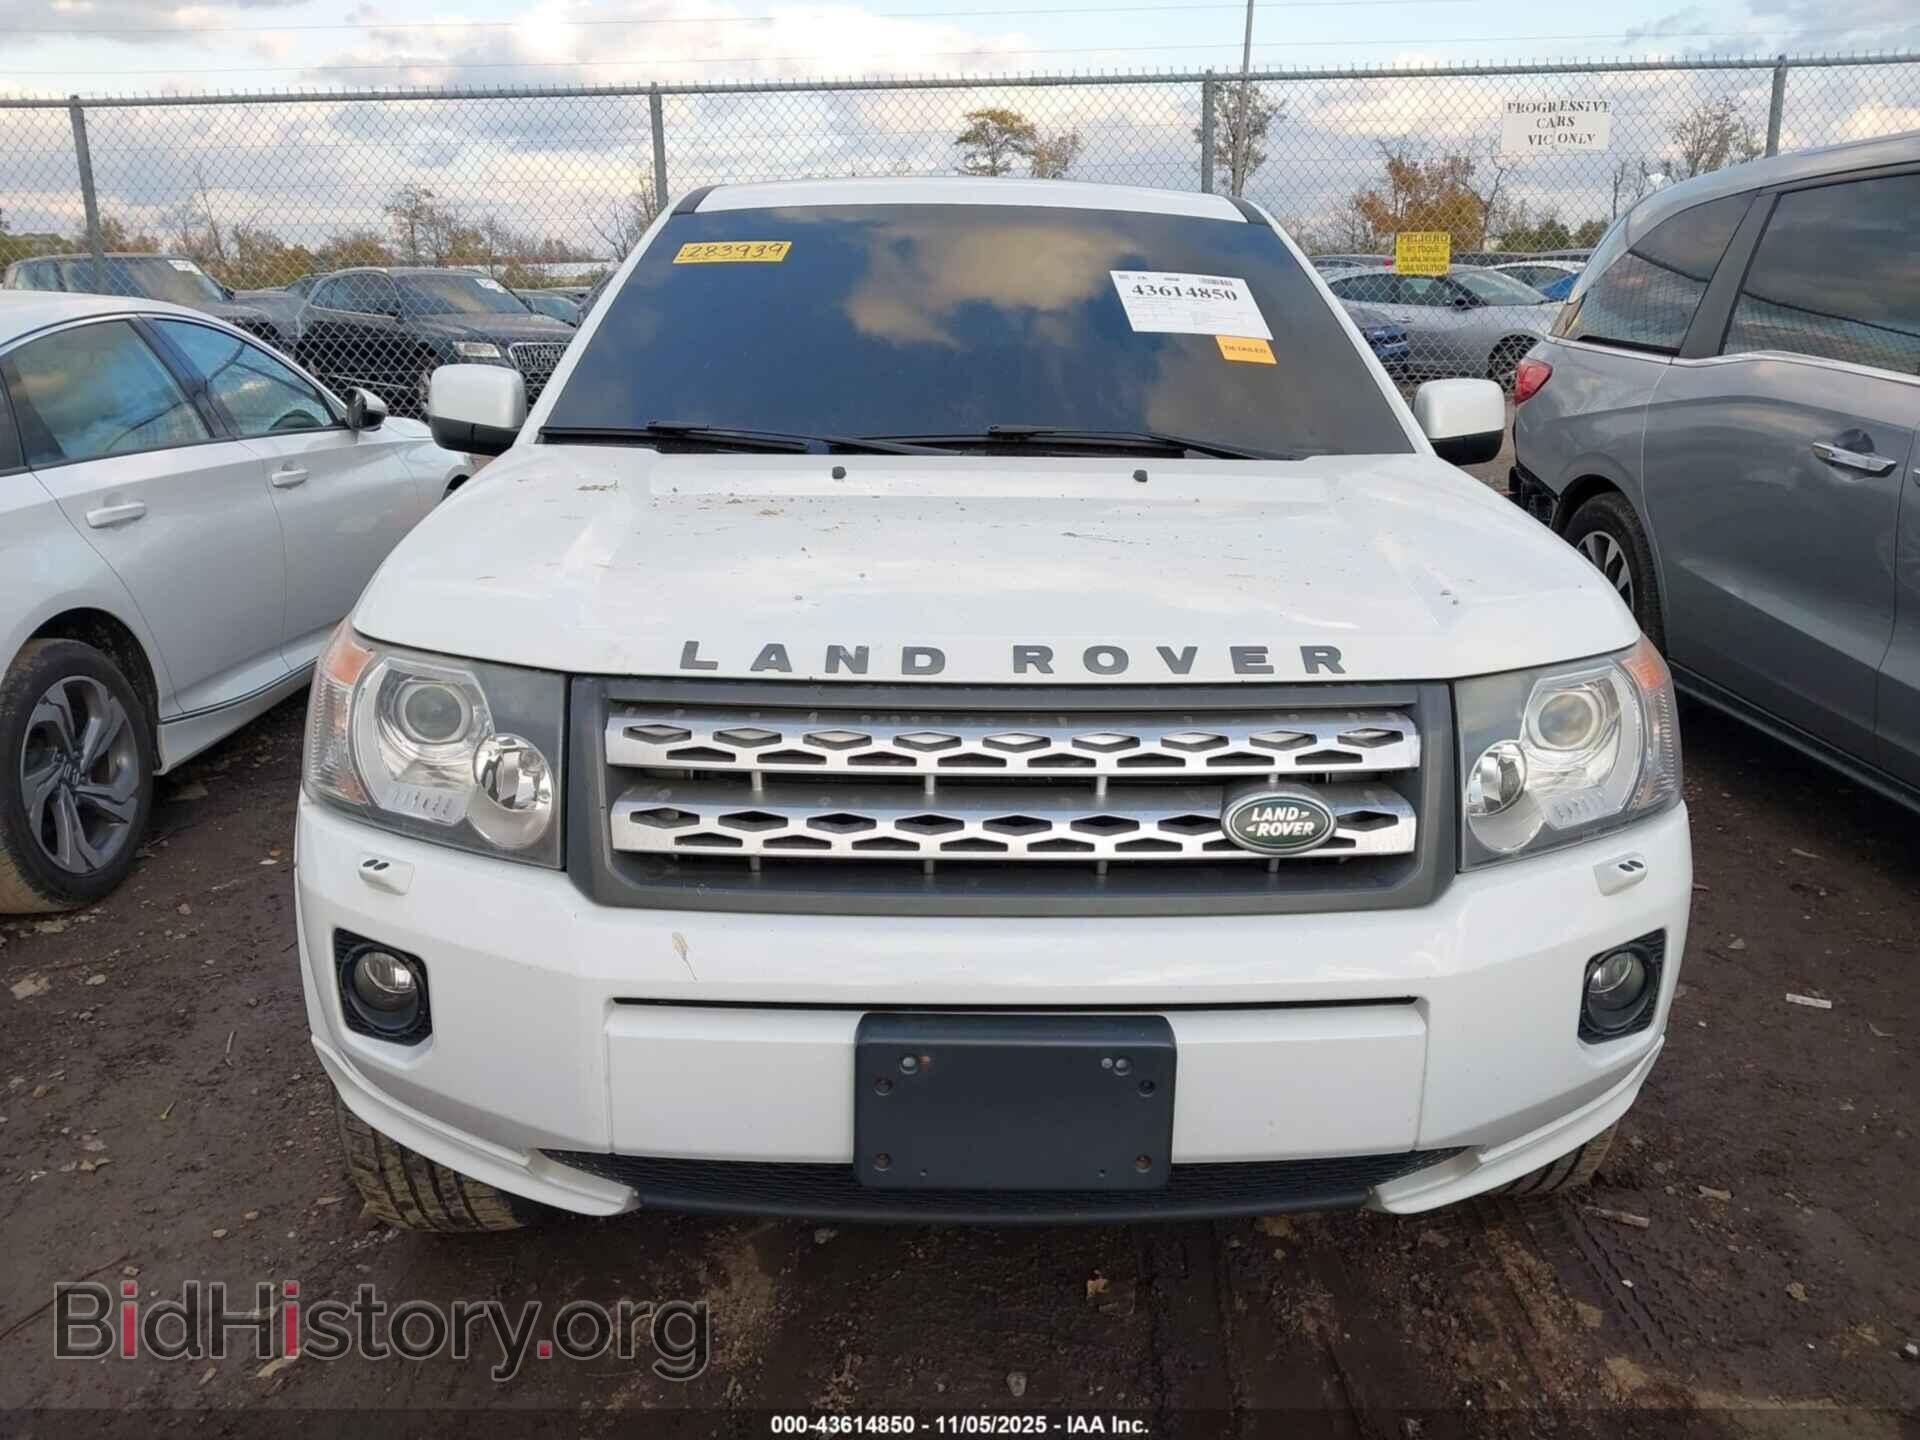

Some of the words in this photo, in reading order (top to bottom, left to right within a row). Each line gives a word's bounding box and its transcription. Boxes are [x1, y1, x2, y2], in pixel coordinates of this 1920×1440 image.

[1507, 100, 1611, 113] PROGRESSIVE
[1536, 115, 1575, 128] CARS
[1557, 132, 1595, 144] ONLY
[1132, 284, 1238, 300] 43614850
[679, 640, 946, 675] LAND
[1012, 645, 1346, 675] ROVER
[1256, 821, 1315, 836] ROVER
